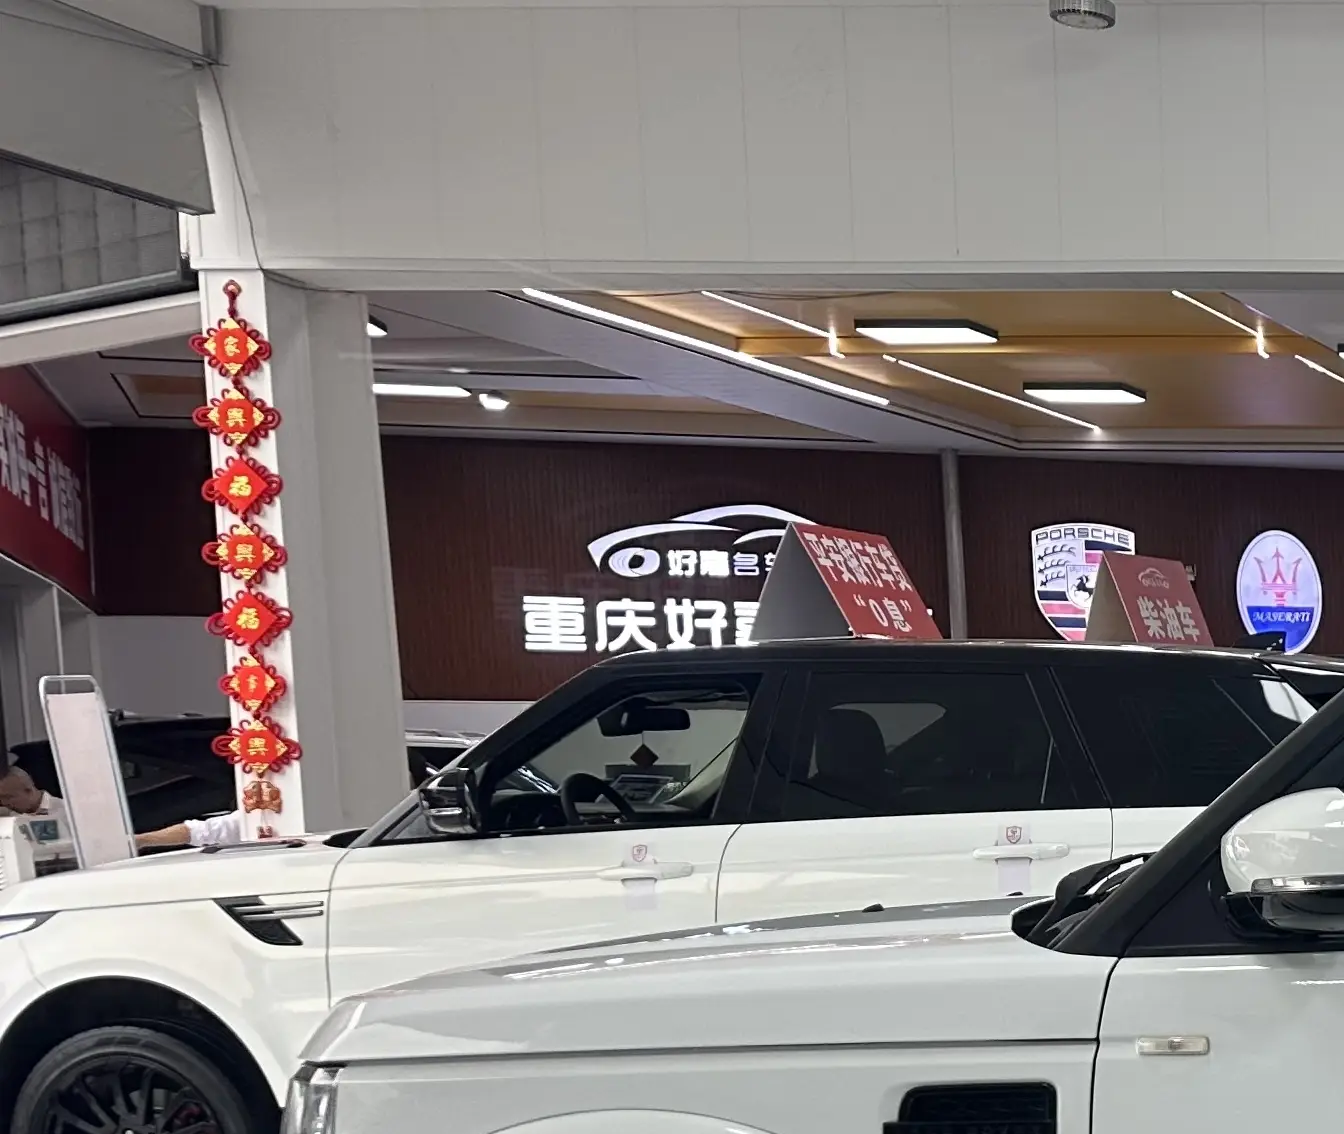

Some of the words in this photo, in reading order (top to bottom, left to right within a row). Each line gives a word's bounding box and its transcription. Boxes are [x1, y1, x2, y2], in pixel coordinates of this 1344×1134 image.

[1035, 527, 1130, 546] PORSCHE
[803, 531, 914, 592] 平安银行车贷
[1136, 595, 1200, 642] 柴油车
[1252, 610, 1311, 624] MASERATI
